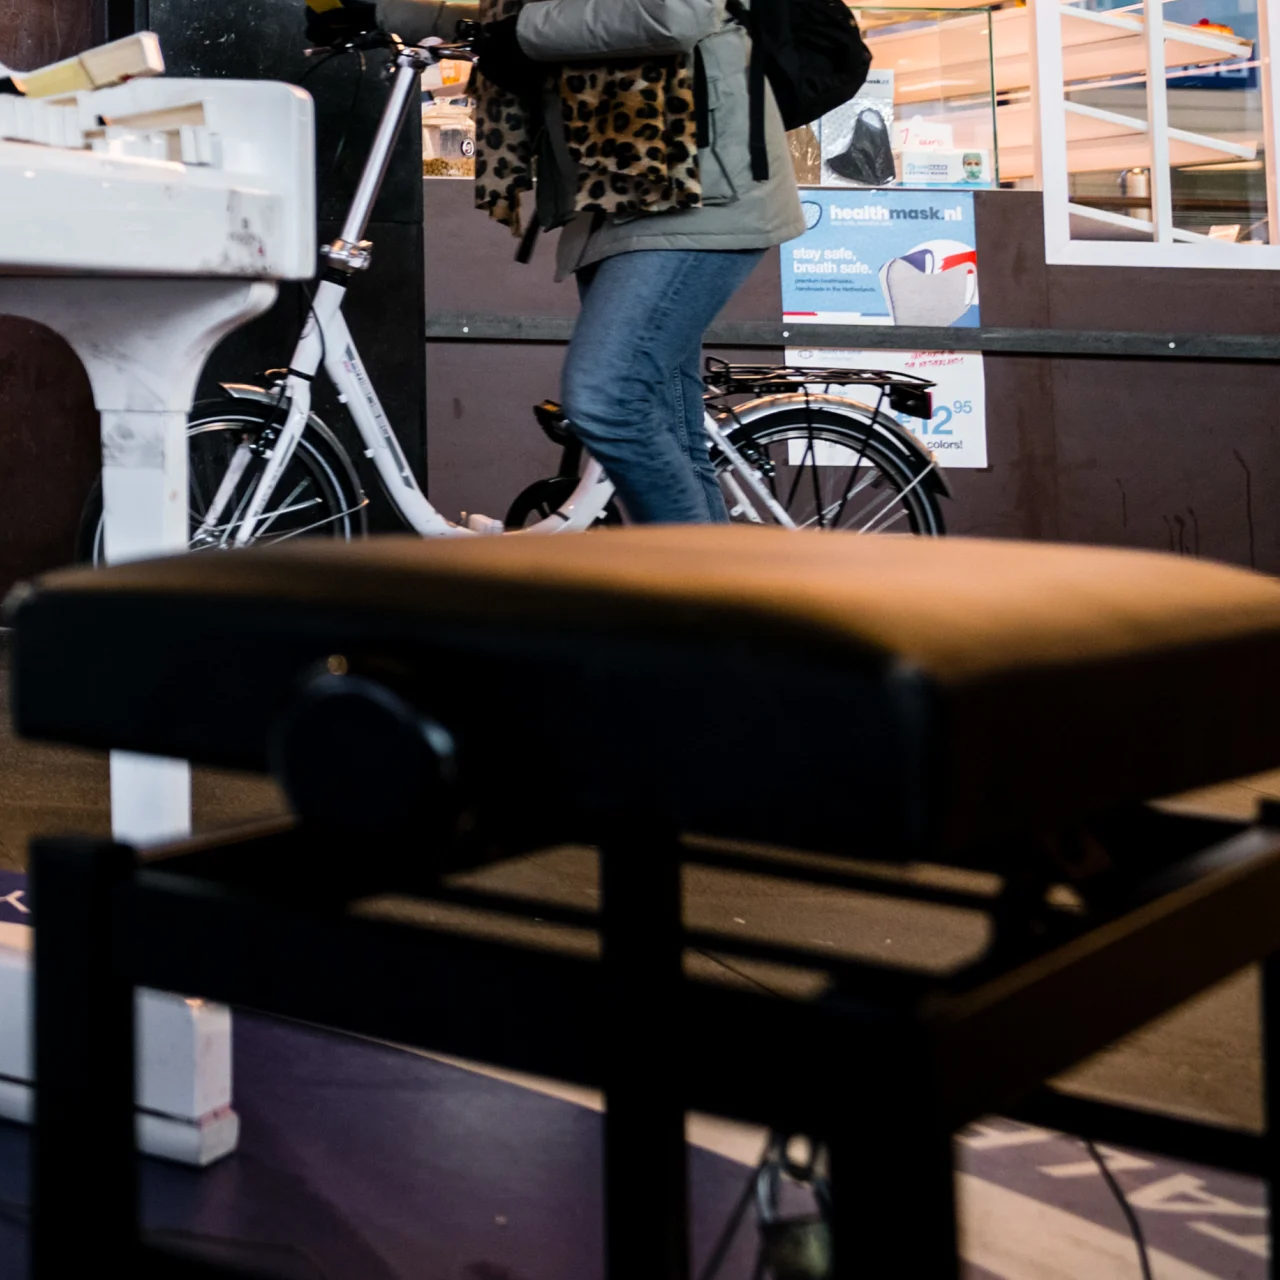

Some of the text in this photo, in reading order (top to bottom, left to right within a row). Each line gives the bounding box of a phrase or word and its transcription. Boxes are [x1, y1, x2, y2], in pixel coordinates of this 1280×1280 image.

[829, 204, 963, 222] healthmask.nl
[793, 246, 857, 262] stay safe,
[793, 261, 873, 274] breath safe.
[953, 400, 973, 414] 95
[927, 439, 963, 449] colors!
